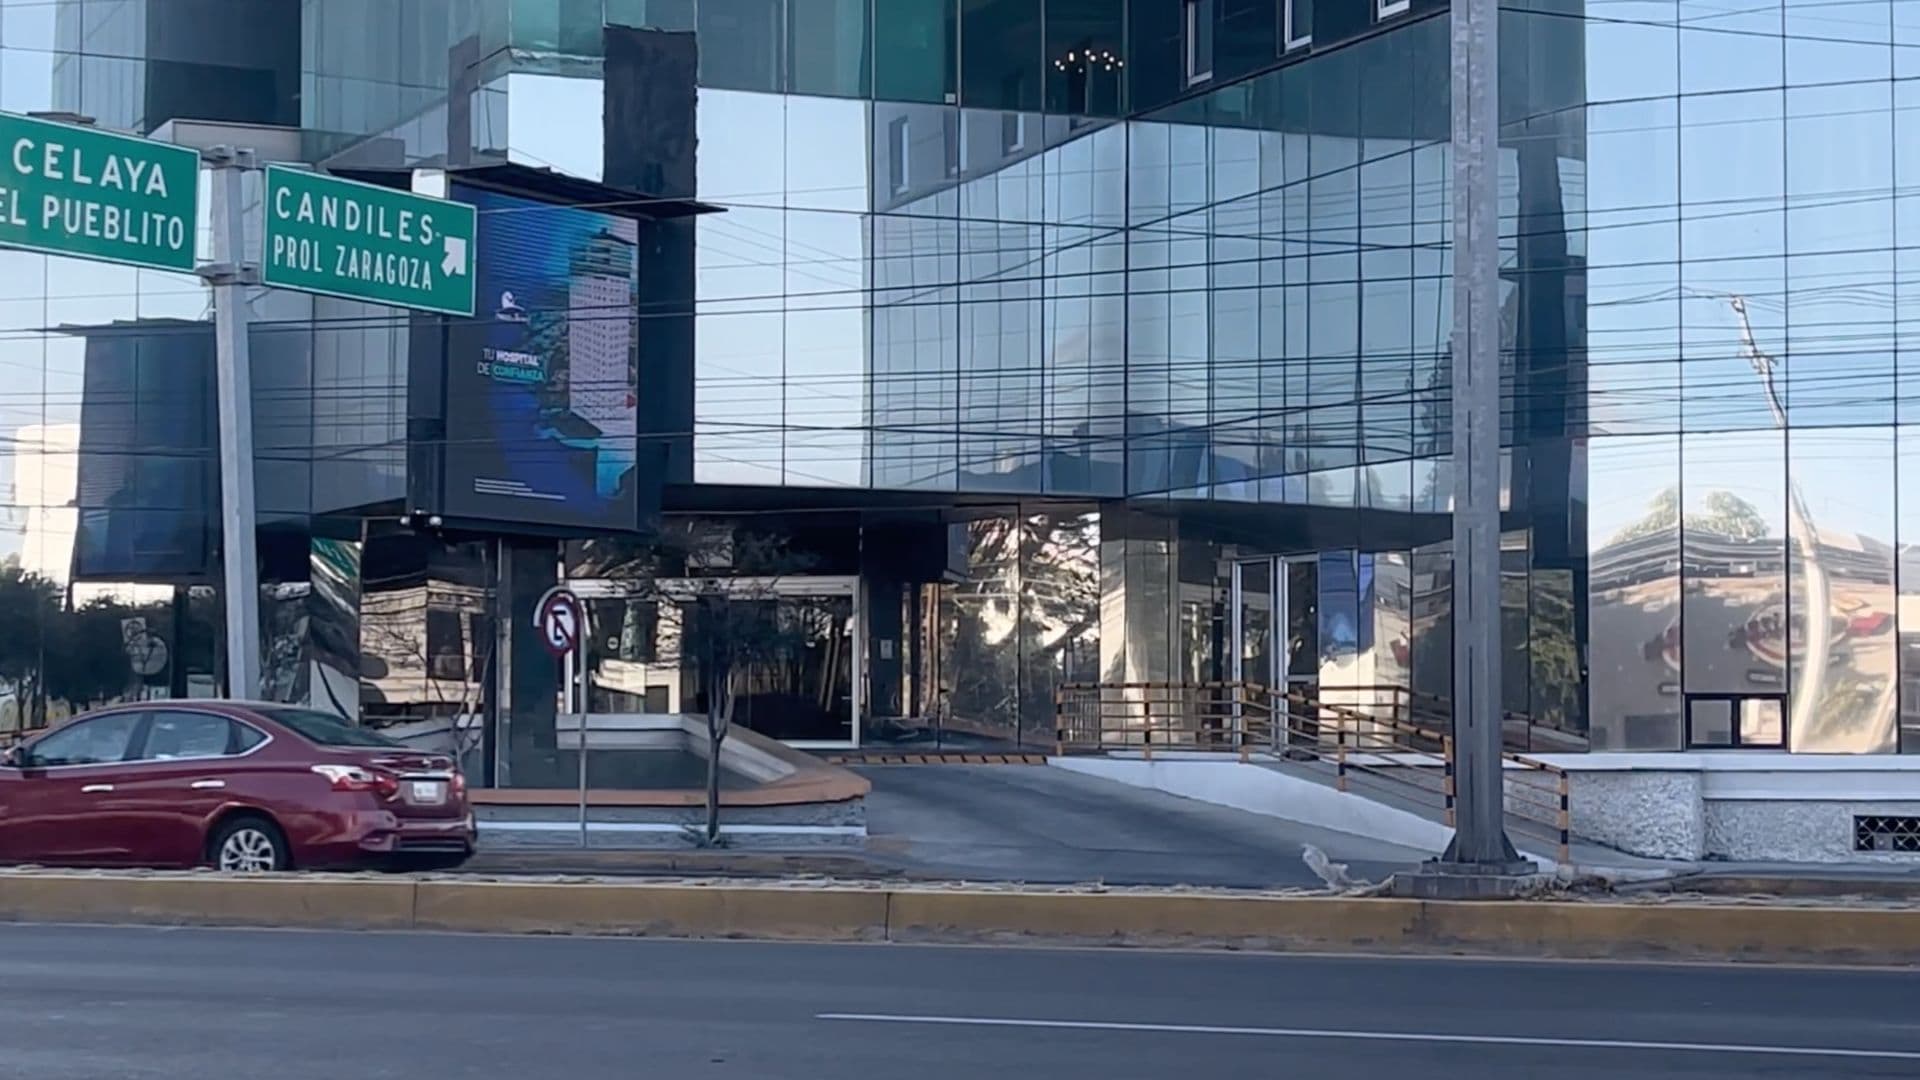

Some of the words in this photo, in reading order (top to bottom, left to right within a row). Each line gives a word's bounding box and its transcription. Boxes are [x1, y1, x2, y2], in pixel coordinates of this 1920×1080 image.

[13, 138, 168, 197] CELAYA
[42, 194, 184, 250] PUEBLITO
[276, 186, 433, 245] CANDILES
[274, 235, 323, 273] PROL
[335, 245, 433, 291] ZARAGOZA
[477, 361, 490, 375] DE
